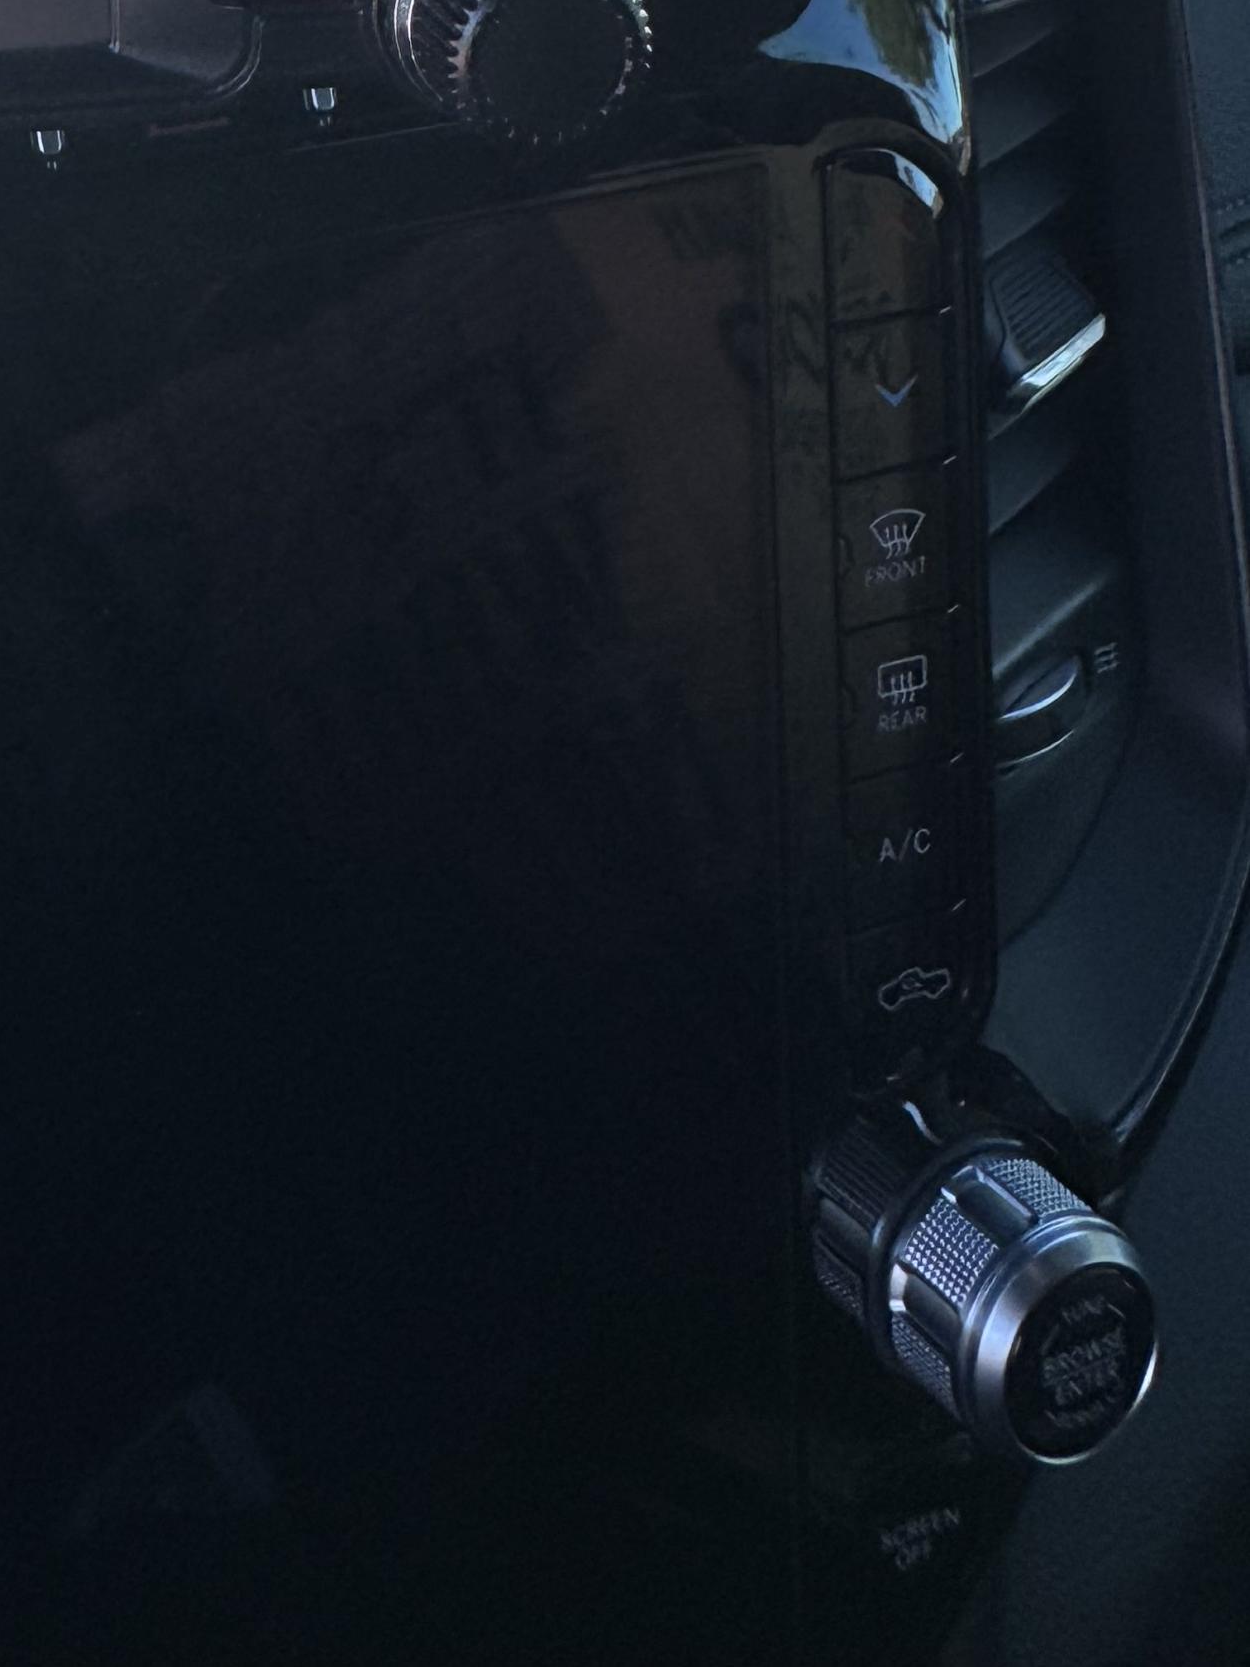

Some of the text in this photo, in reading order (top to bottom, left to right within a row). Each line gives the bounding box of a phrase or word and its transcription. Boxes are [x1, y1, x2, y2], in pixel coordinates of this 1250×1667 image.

[865, 556, 927, 587] FRONT
[877, 705, 928, 732] REAR
[879, 828, 933, 864] A/C
